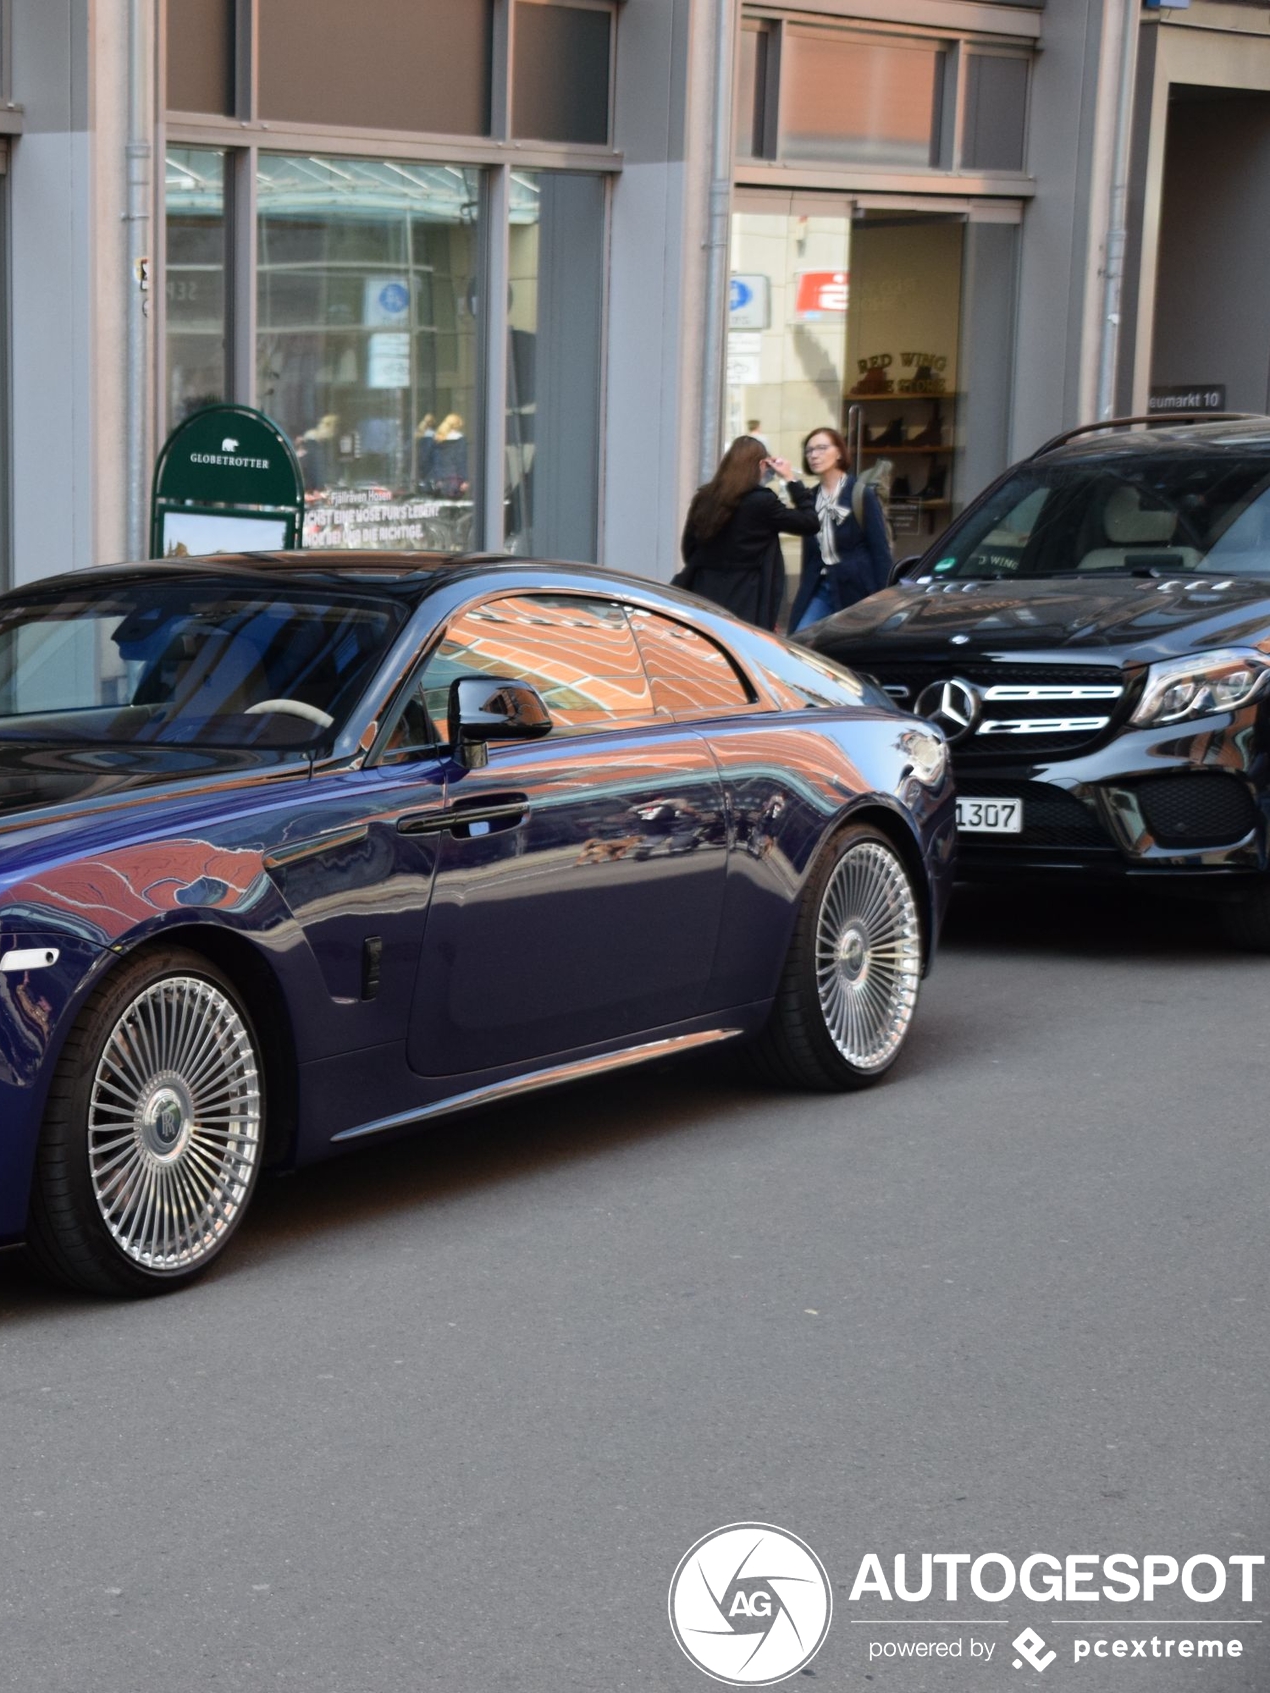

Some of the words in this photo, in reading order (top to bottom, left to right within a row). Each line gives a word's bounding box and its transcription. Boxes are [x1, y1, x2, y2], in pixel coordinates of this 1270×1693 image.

[857, 353, 892, 374] RED
[899, 352, 947, 372] WING
[1150, 392, 1200, 408] eumarkt
[1203, 392, 1219, 407] 10
[190, 453, 270, 469] GLOBETROTTER
[990, 555, 1019, 570] WING
[955, 803, 1016, 828] 1307
